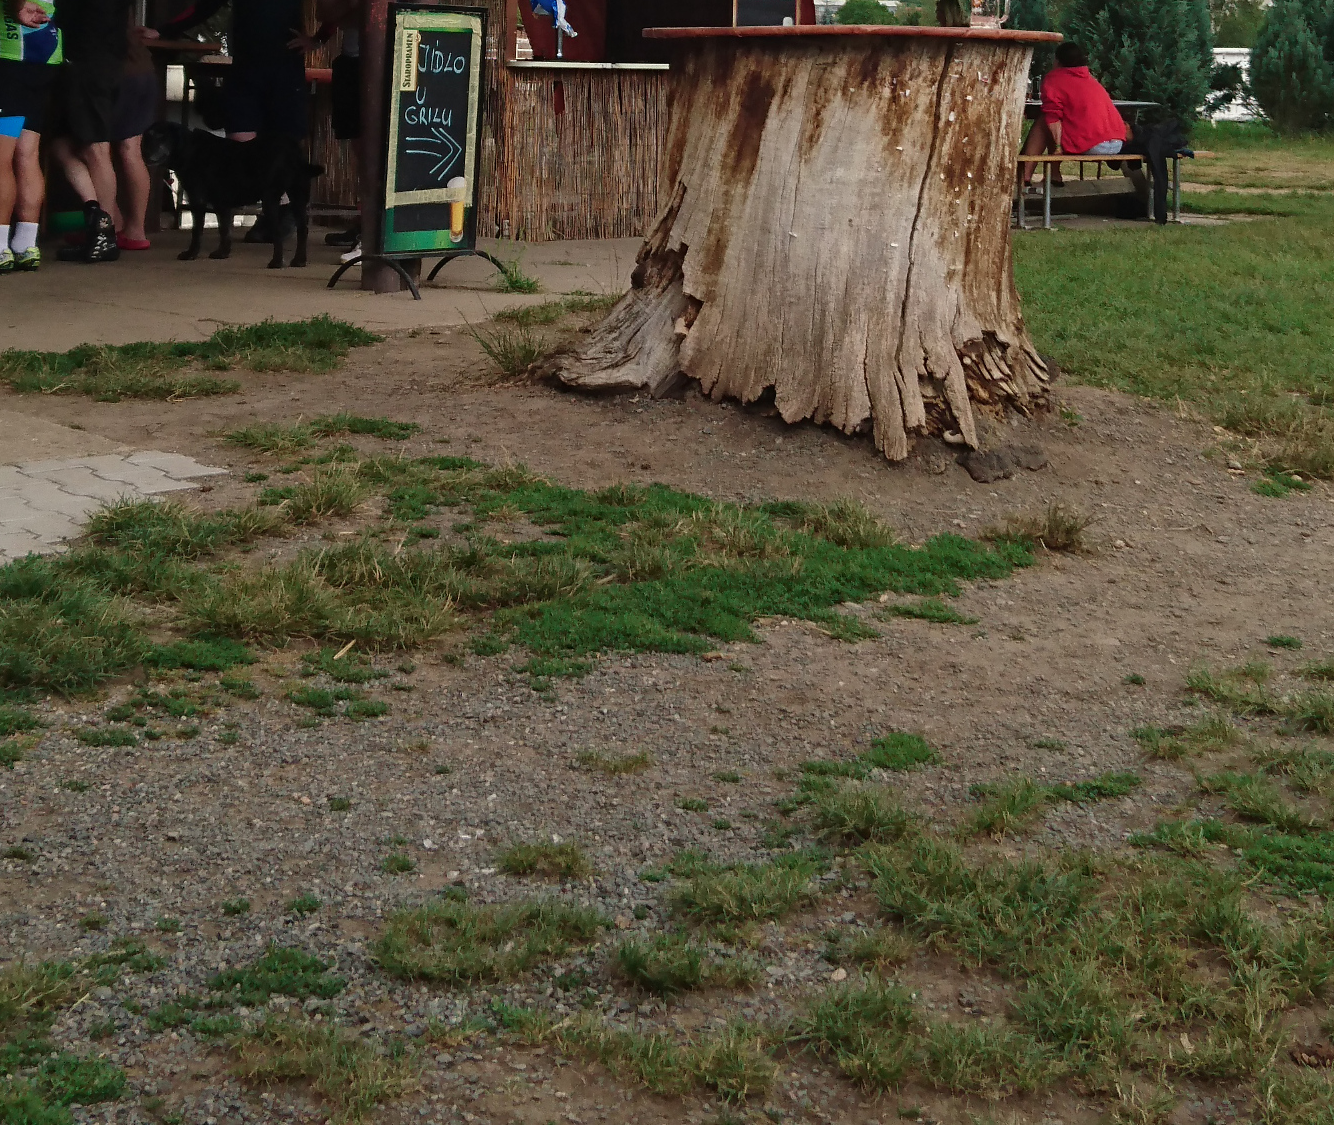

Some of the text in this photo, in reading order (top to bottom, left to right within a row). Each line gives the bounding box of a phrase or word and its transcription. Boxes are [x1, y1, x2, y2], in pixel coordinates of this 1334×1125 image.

[402, 32, 413, 88] STAROPRAMEN
[418, 39, 465, 74] JÍDLO
[415, 86, 427, 105] U
[404, 106, 452, 127] GRILU
